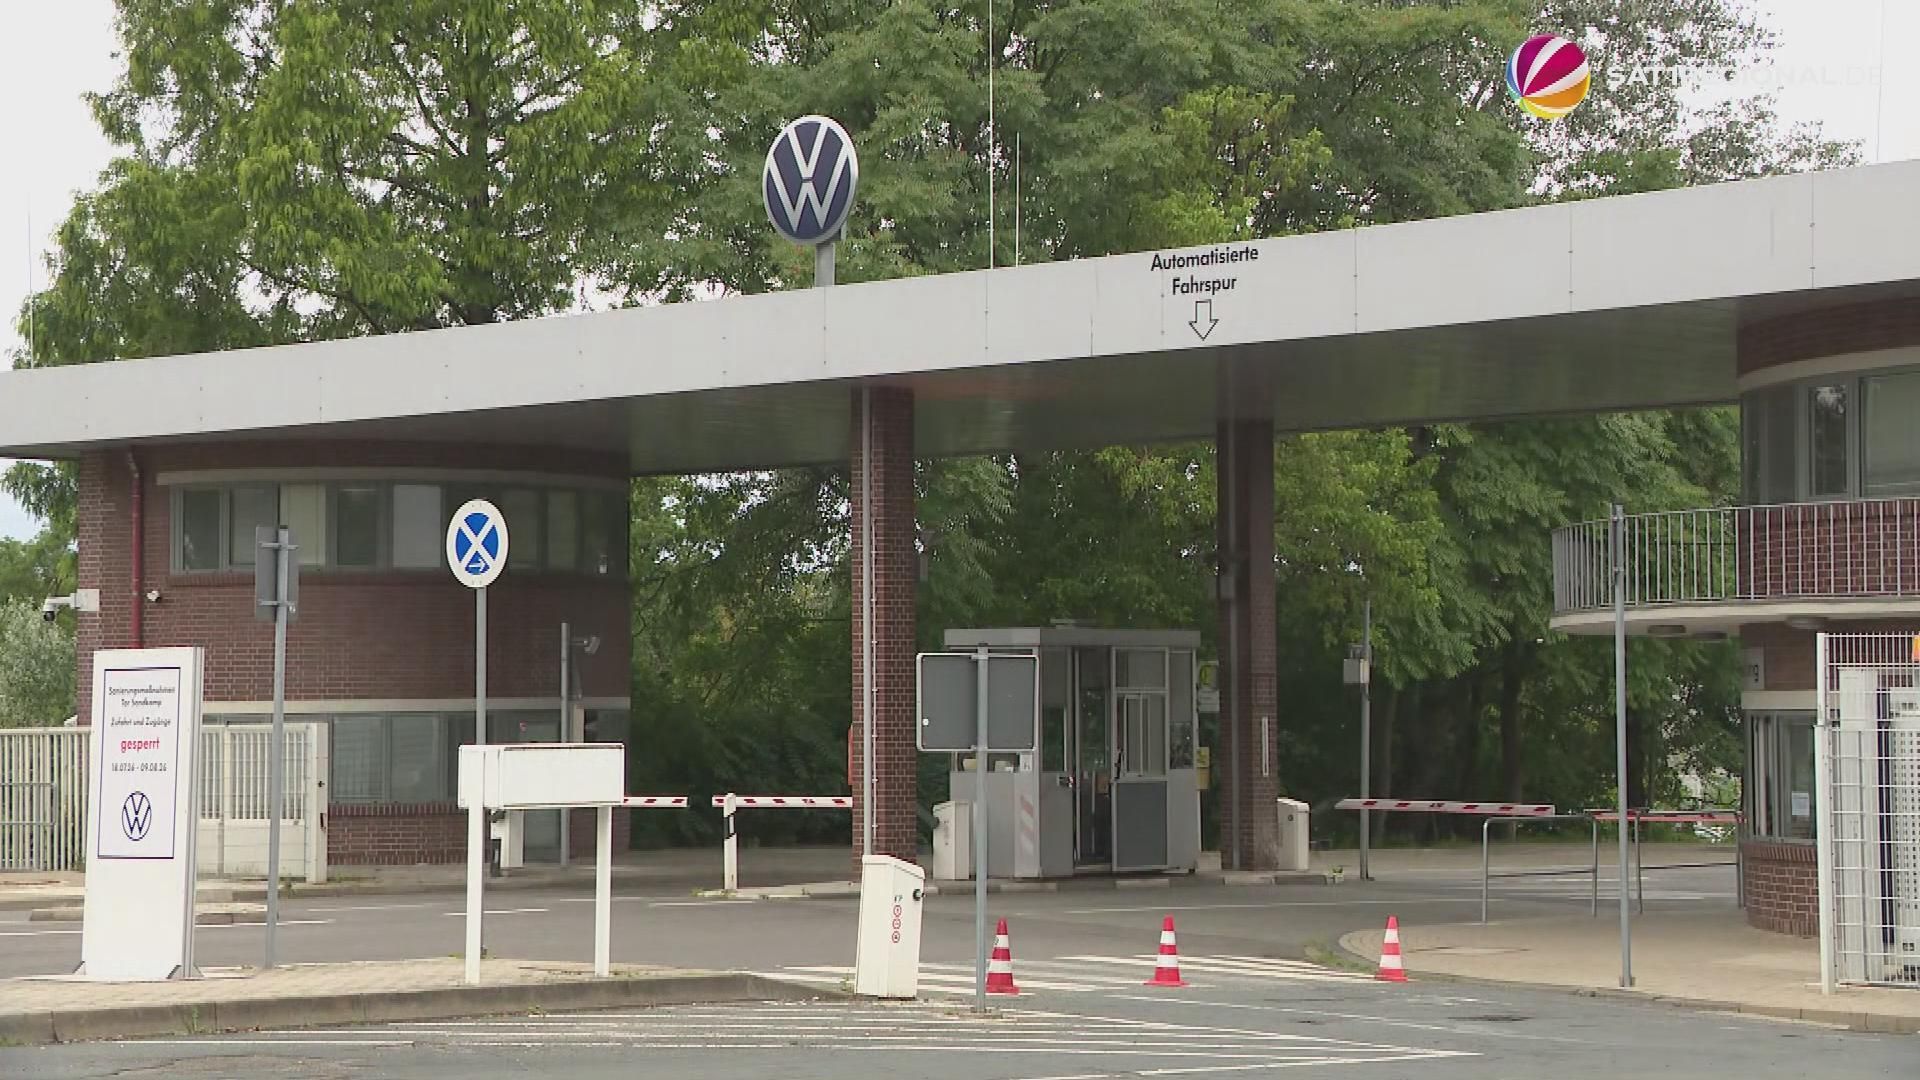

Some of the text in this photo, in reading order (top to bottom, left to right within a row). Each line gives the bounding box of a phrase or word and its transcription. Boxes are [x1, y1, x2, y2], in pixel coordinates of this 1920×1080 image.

[1150, 246, 1259, 272] Automatisierte
[1172, 274, 1237, 296] Fahrspur
[133, 716, 144, 726] und
[121, 737, 159, 753] gesperrt
